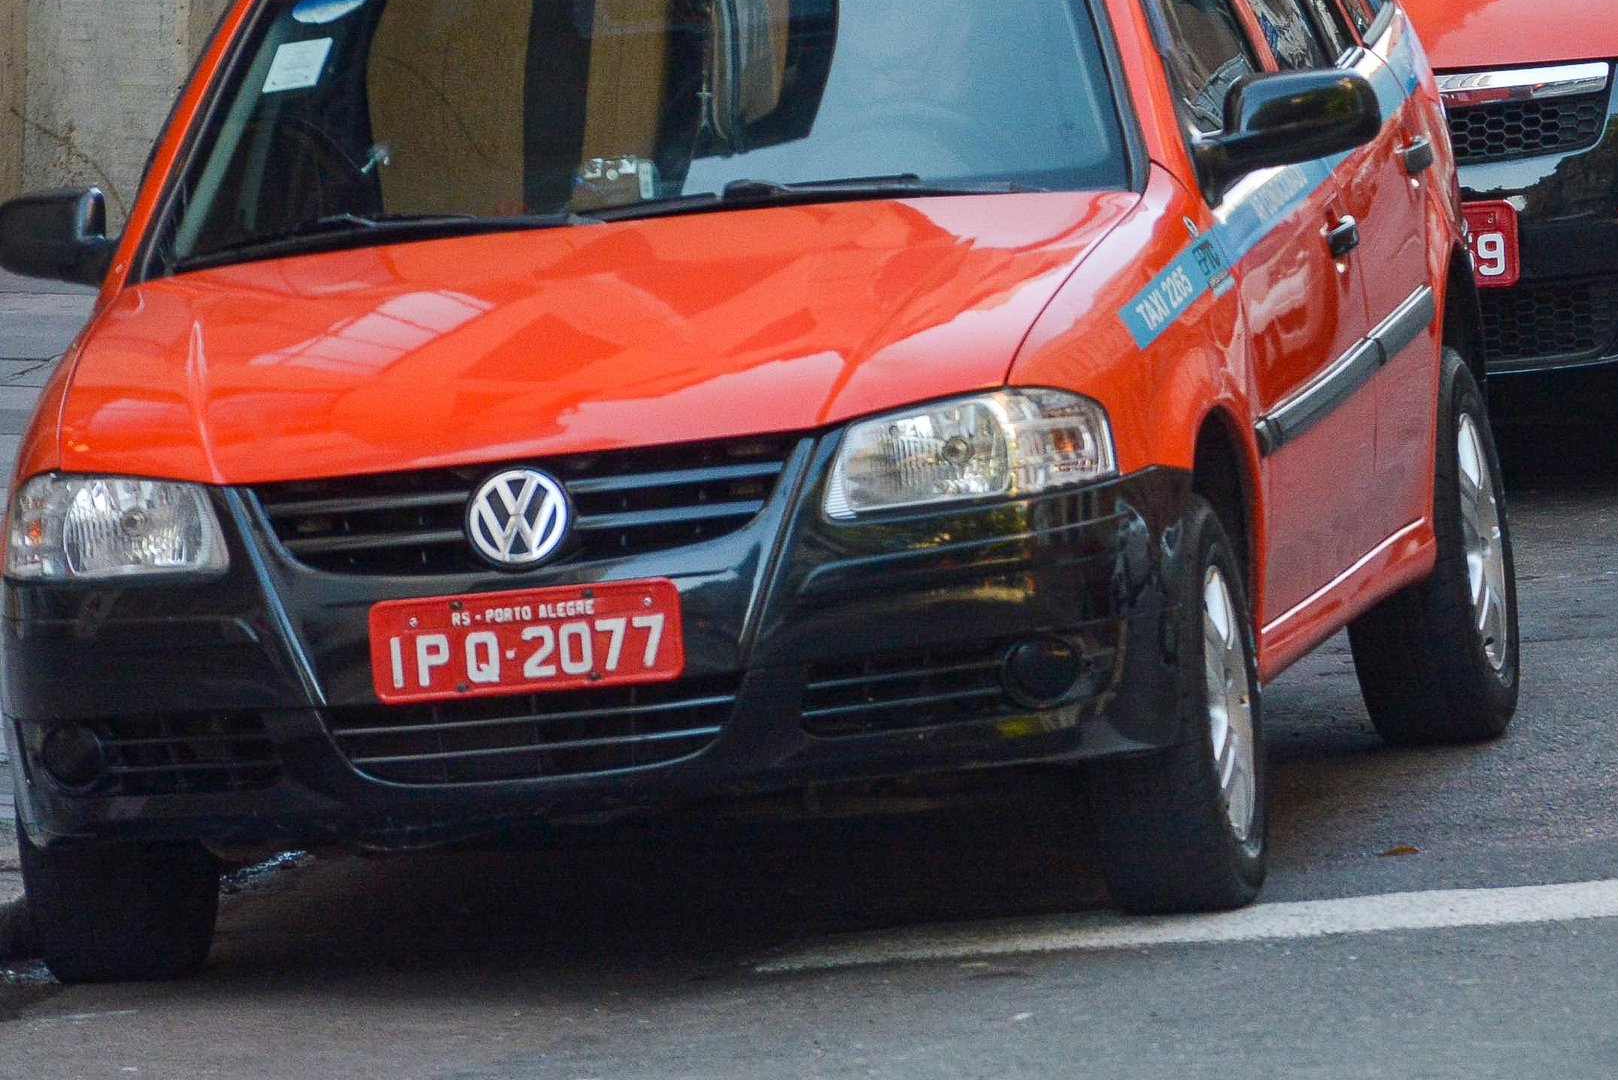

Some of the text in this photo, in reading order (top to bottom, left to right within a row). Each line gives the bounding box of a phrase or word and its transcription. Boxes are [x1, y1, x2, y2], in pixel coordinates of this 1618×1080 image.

[1466, 231, 1506, 276] 9
[1135, 265, 1193, 331] TAXI 2265
[470, 469, 567, 563] VW
[451, 611, 471, 628] RS
[485, 607, 532, 624] PORTO
[538, 599, 596, 619] ALEGRE
